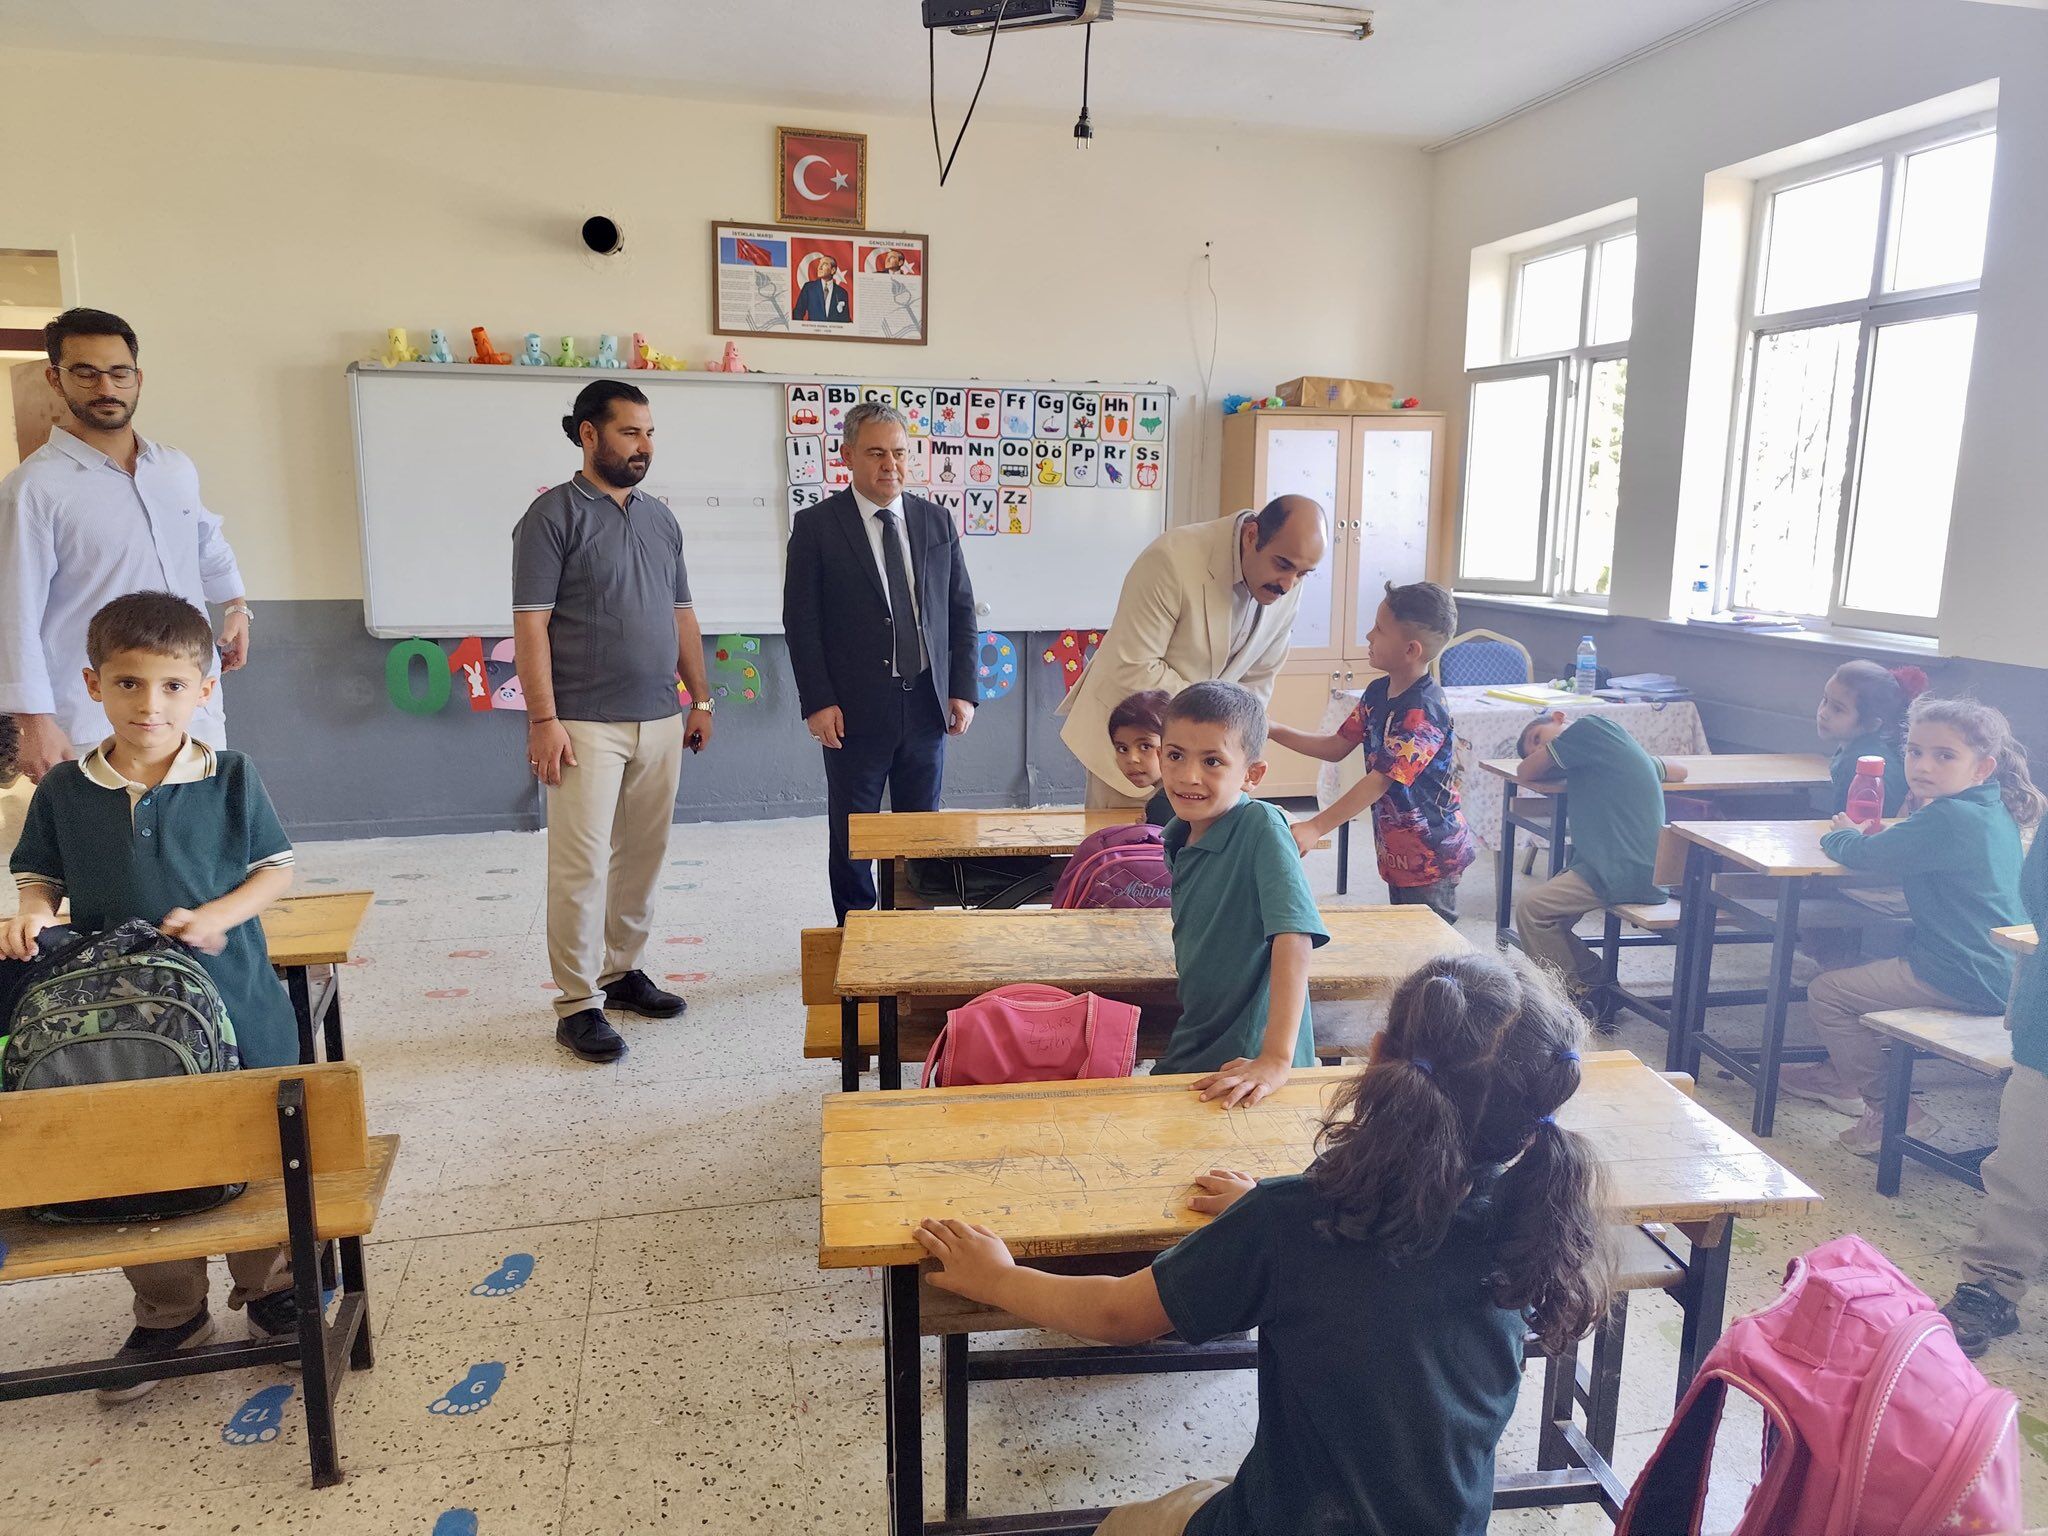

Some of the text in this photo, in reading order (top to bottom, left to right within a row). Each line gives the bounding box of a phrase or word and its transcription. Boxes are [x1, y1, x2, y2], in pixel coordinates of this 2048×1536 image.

[792, 388, 819, 402] Aa
[828, 388, 856, 403] Bb
[900, 390, 927, 408] Çç
[936, 392, 961, 406] Dd
[971, 394, 996, 408] Ee
[1007, 394, 1026, 410] Ff
[1038, 395, 1064, 413] Gg
[1072, 392, 1096, 416] Ğğ
[1104, 398, 1128, 412] Hh
[828, 439, 839, 453] J
[932, 441, 963, 455] Mm
[968, 442, 994, 457] Nn
[1003, 442, 1028, 457] Oo
[1035, 441, 1062, 458] Öö
[1072, 444, 1095, 461] Pp
[1104, 446, 1126, 459] Rr
[1137, 447, 1160, 461] Ss
[934, 494, 960, 507] Vv
[969, 493, 993, 514] Yy
[1003, 491, 1027, 505] Zz
[448, 636, 493, 711] 1
